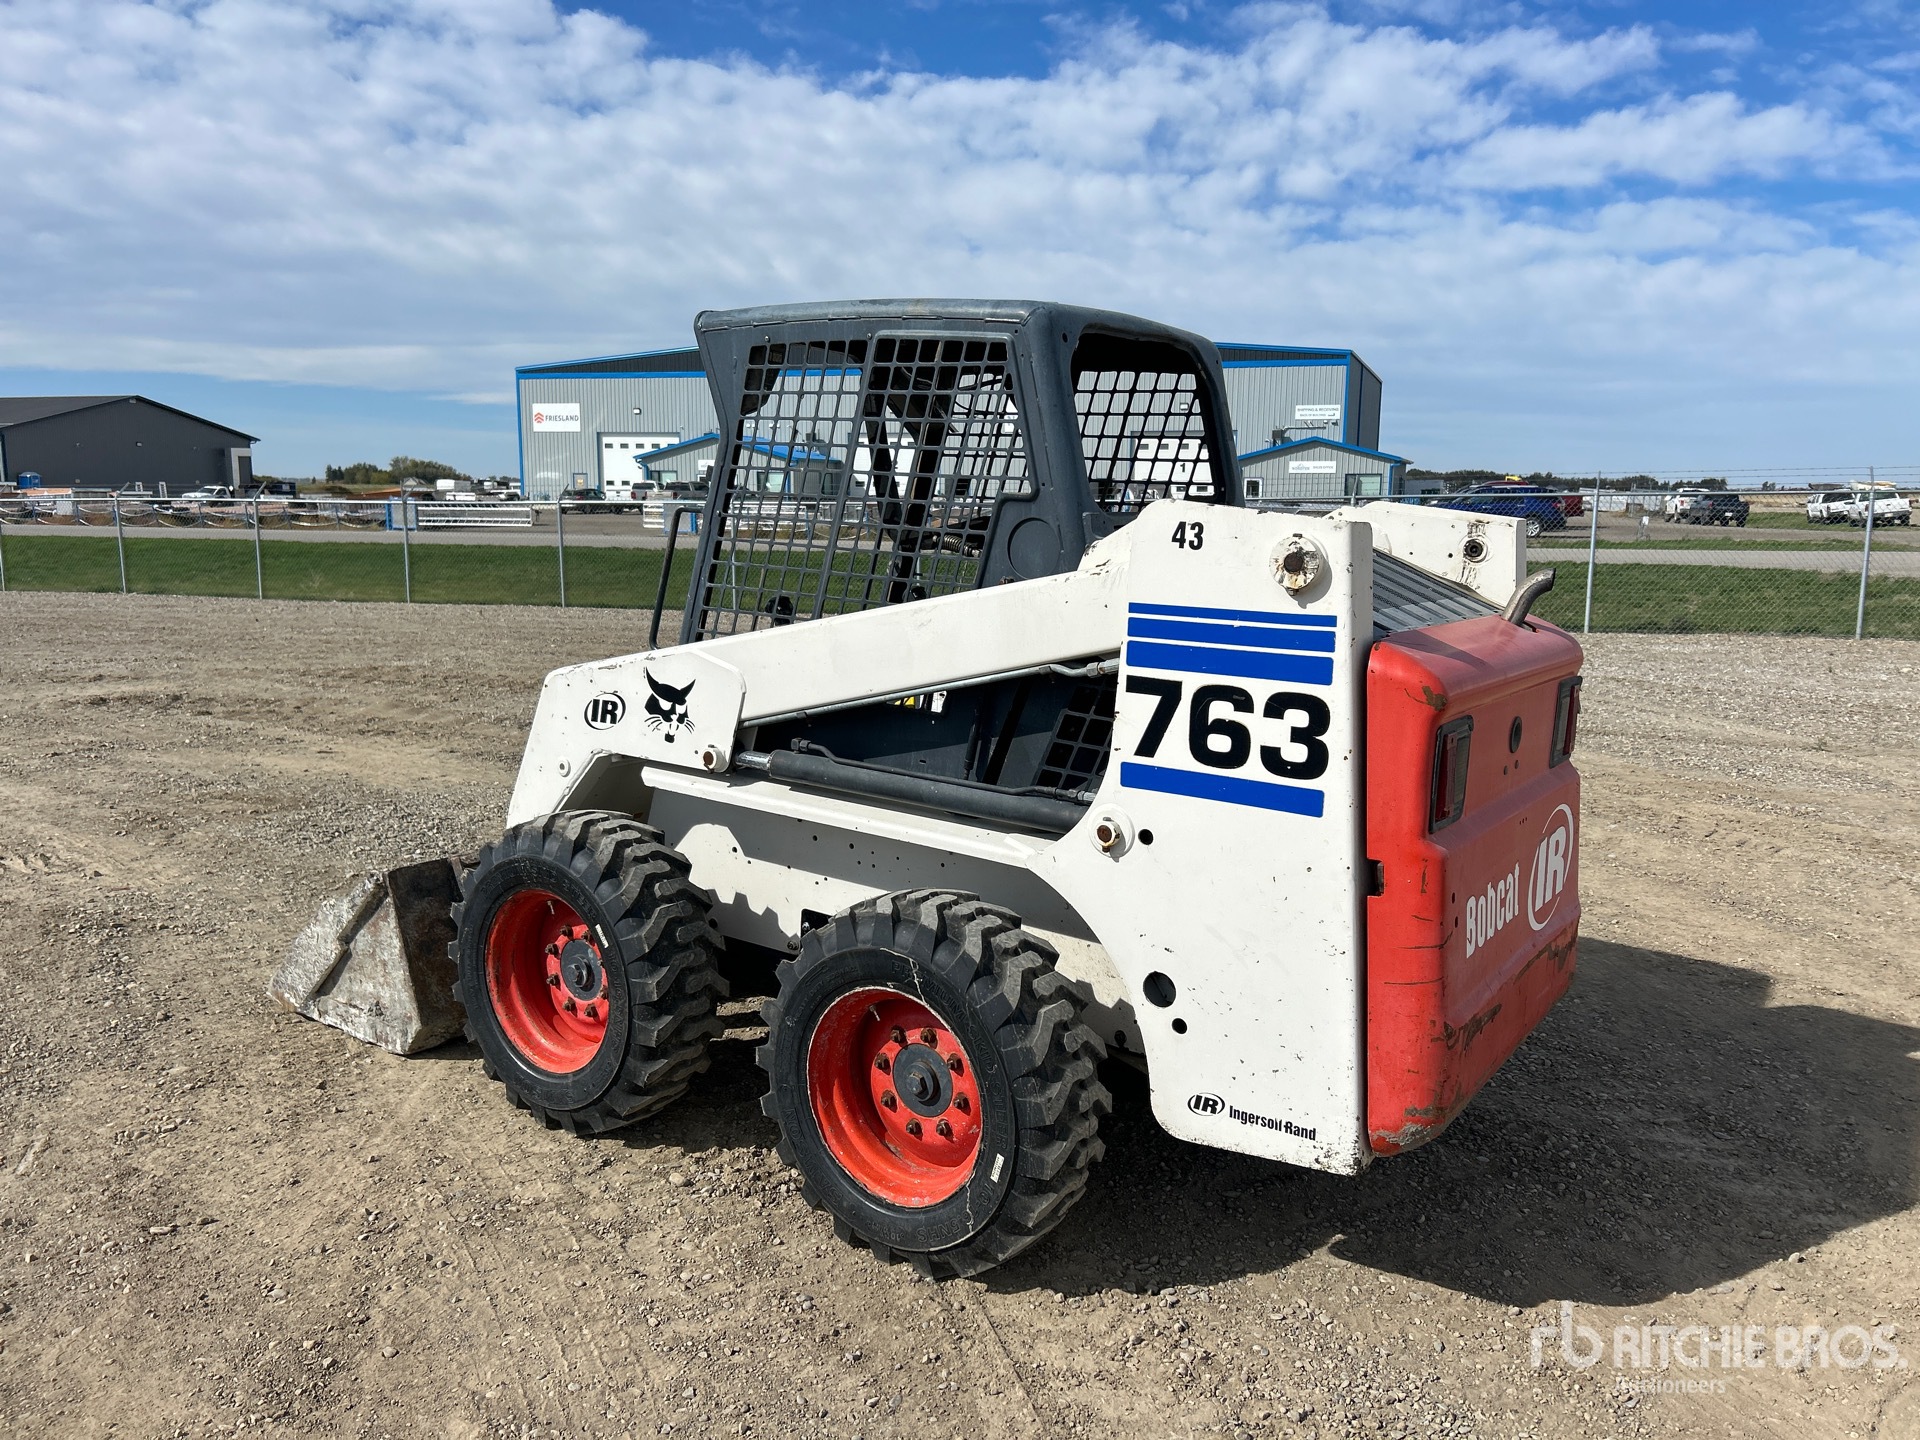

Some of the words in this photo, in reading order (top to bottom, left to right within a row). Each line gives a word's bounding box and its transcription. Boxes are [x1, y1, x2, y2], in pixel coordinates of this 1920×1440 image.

[1180, 462, 1186, 473] 1
[1171, 520, 1205, 550] 43
[591, 698, 619, 725] IR
[1125, 674, 1331, 780] 763
[1534, 825, 1567, 912] IR
[1466, 860, 1520, 959] Bobcat
